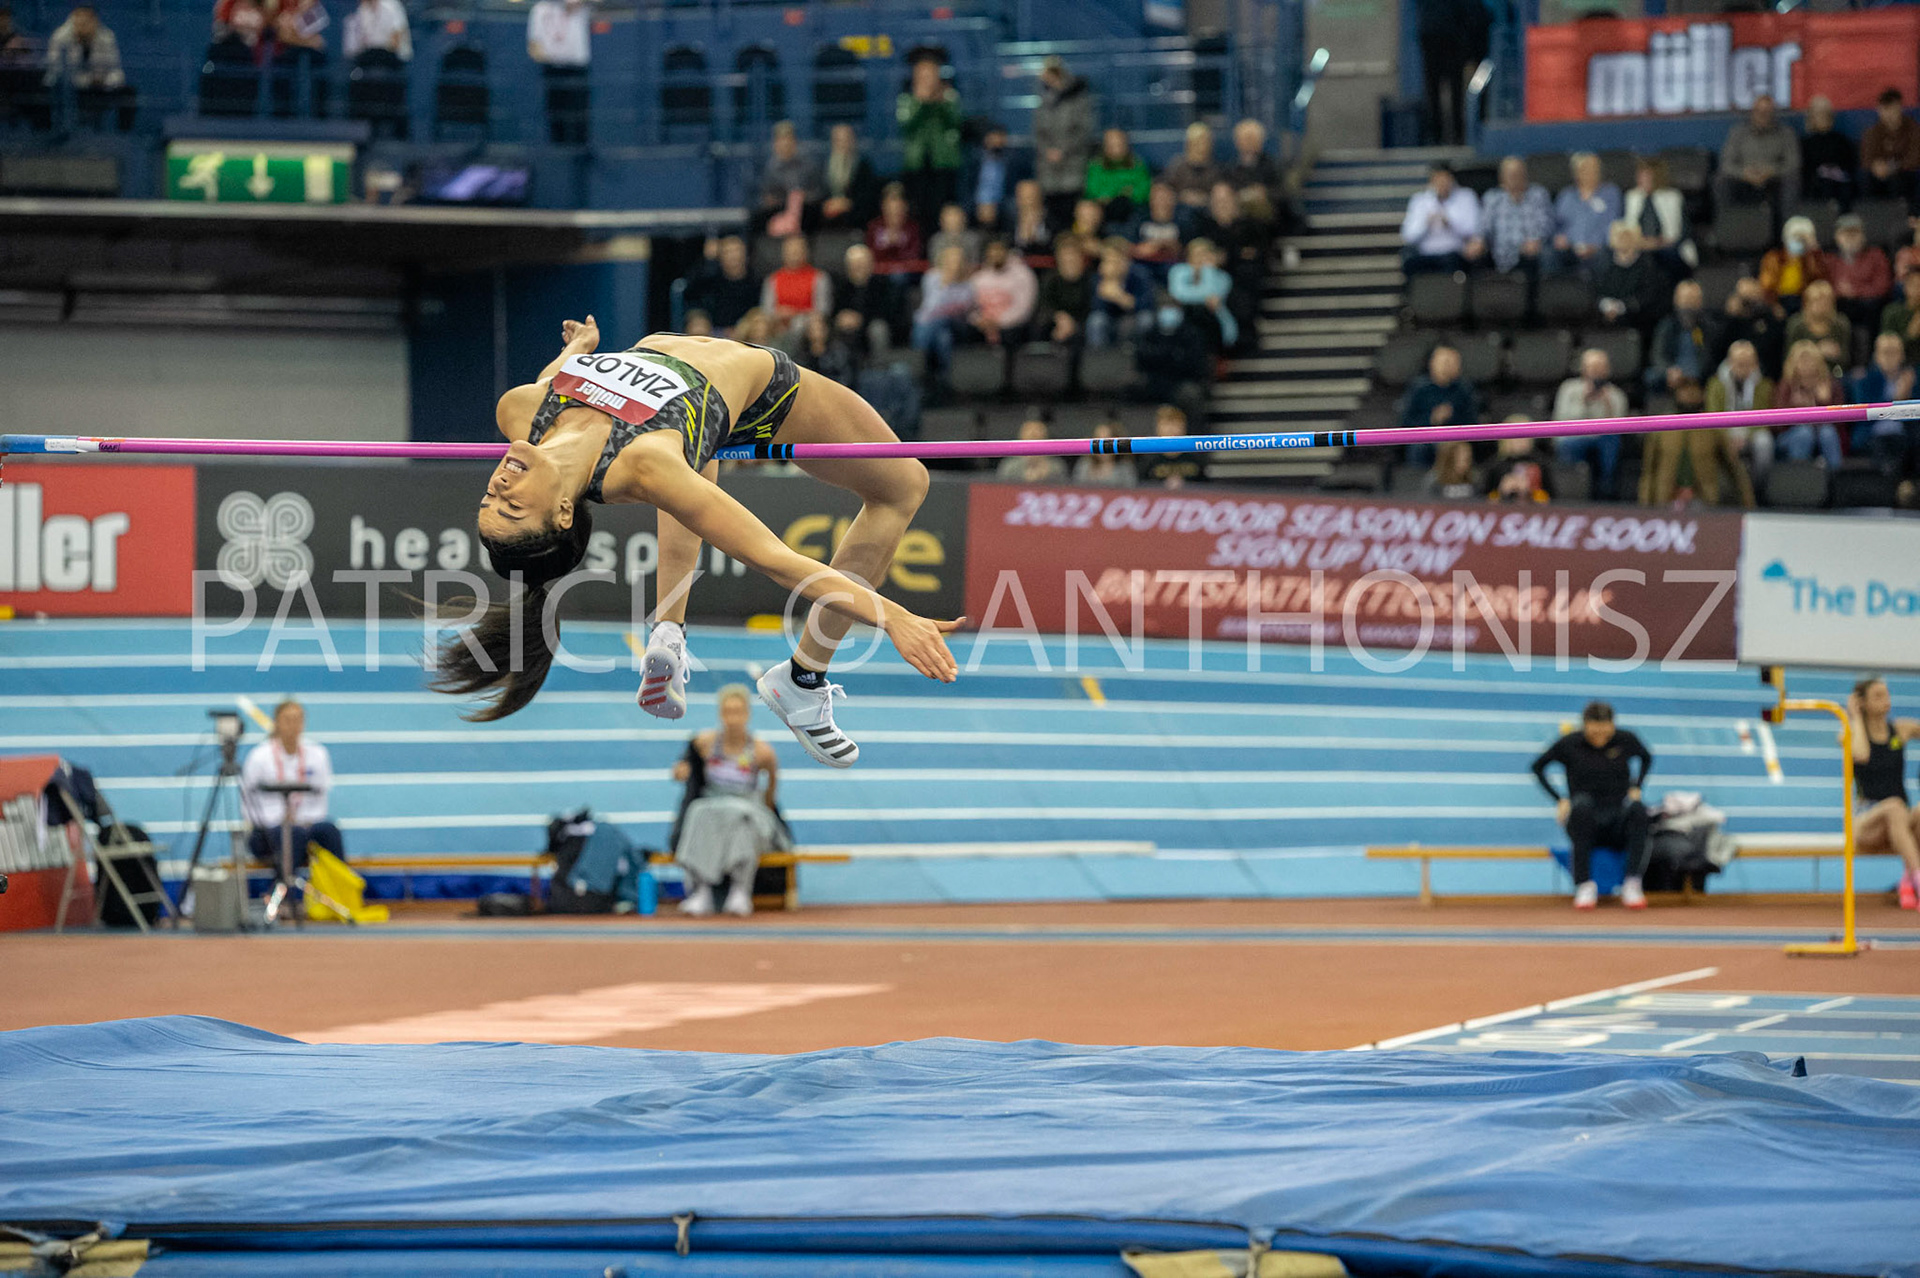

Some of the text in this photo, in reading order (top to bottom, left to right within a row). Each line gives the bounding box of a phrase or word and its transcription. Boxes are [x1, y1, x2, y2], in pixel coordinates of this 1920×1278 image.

[1587, 22, 1801, 116] müller
[575, 381, 628, 410] müller
[1195, 436, 1311, 450] nordicsport.com
[1005, 492, 1101, 528] 2022
[1101, 496, 1287, 534] OUTDOOR
[1283, 503, 1435, 541] SEASON
[1431, 509, 1497, 545] ON
[1492, 512, 1590, 549] SALE
[1208, 533, 1468, 576] SIGN UP NOW
[1788, 575, 1920, 617] The Da
